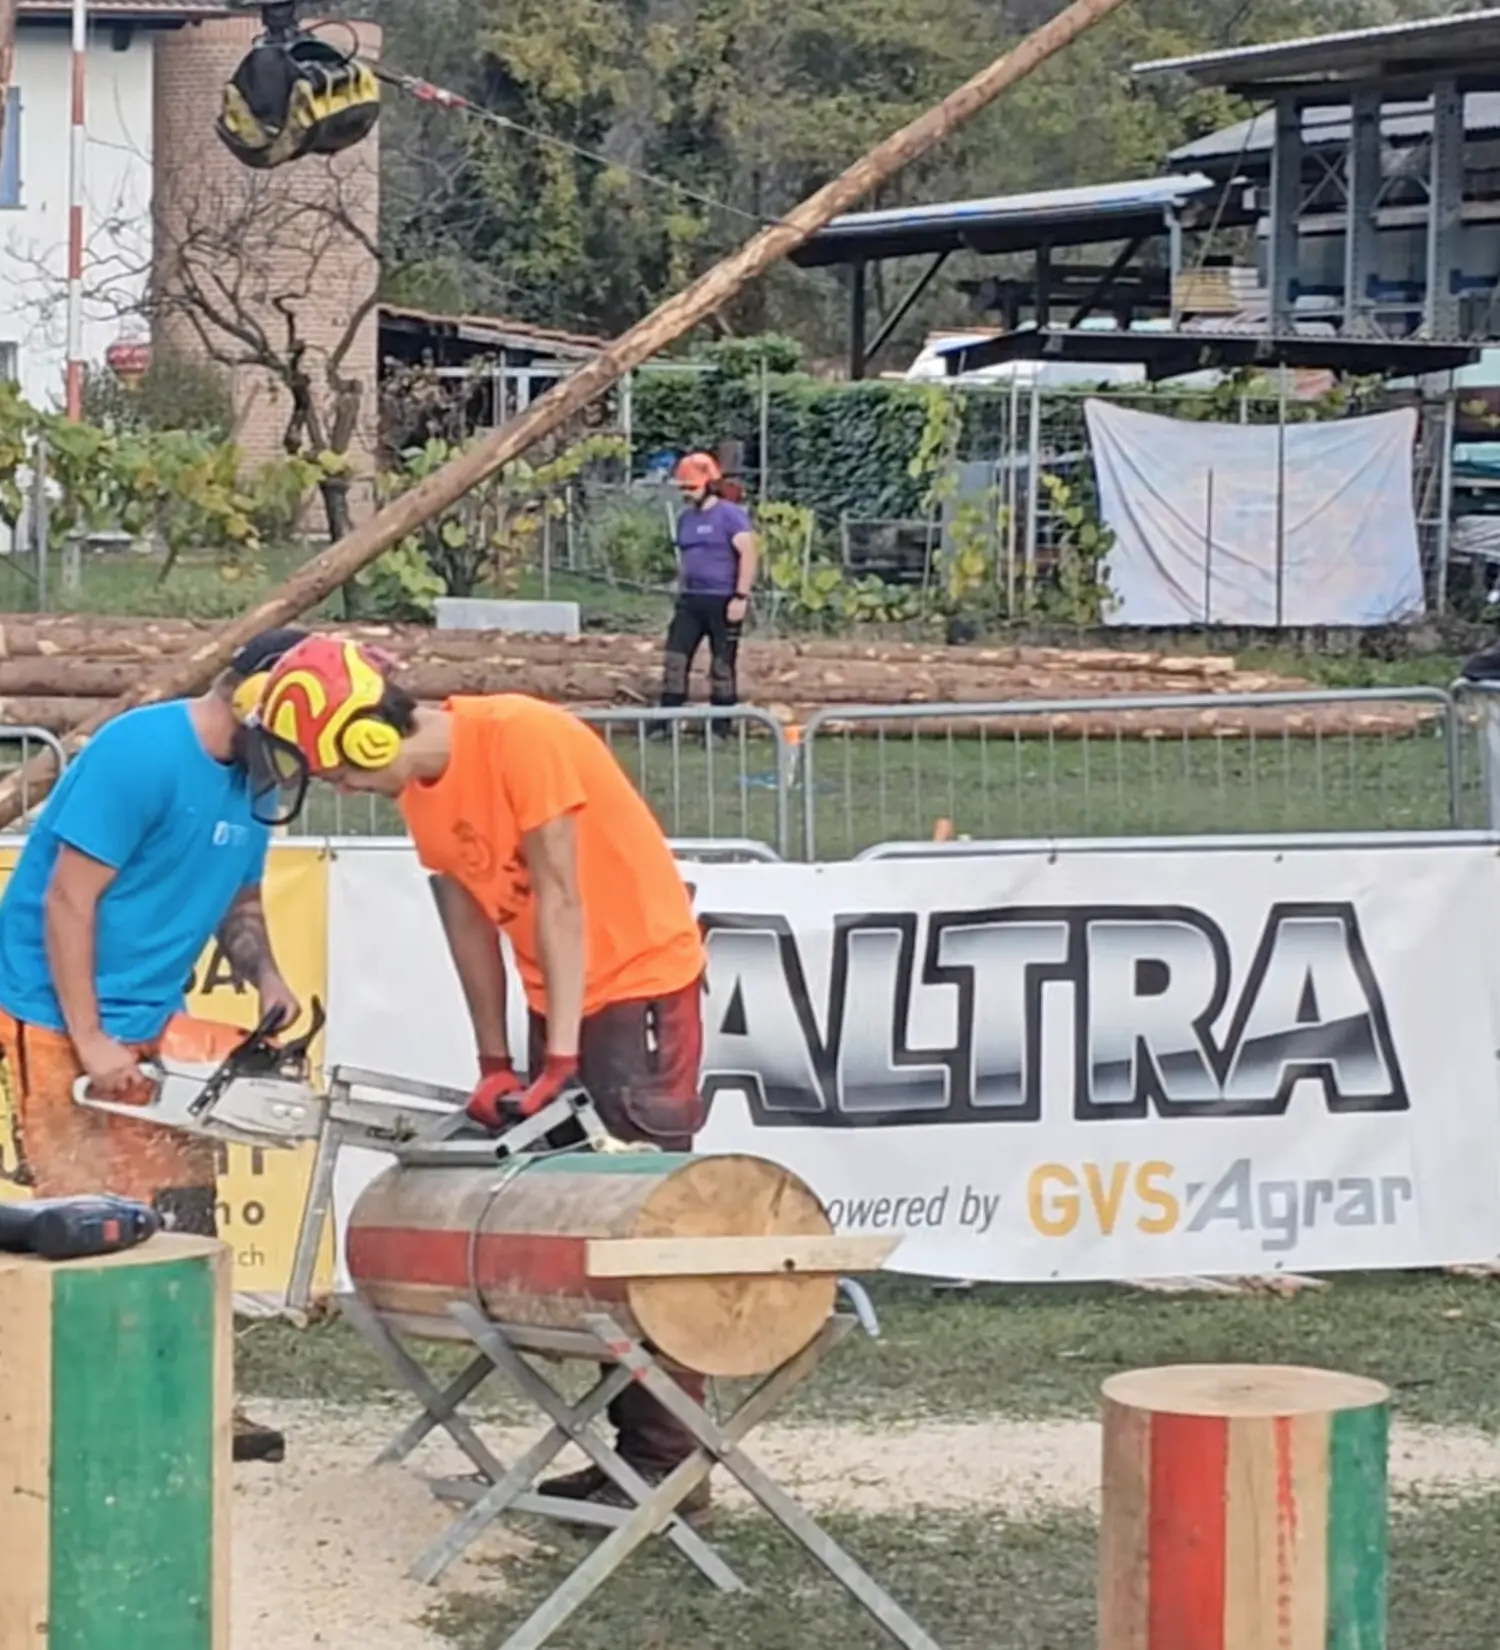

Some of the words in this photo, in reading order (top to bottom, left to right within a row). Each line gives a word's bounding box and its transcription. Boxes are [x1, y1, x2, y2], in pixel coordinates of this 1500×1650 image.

[695, 902, 1410, 1128] ALTRA
[827, 1184, 950, 1228] owered
[959, 1184, 1001, 1234] by
[1027, 1160, 1181, 1238] GVS
[1184, 1157, 1413, 1252] Agrar
